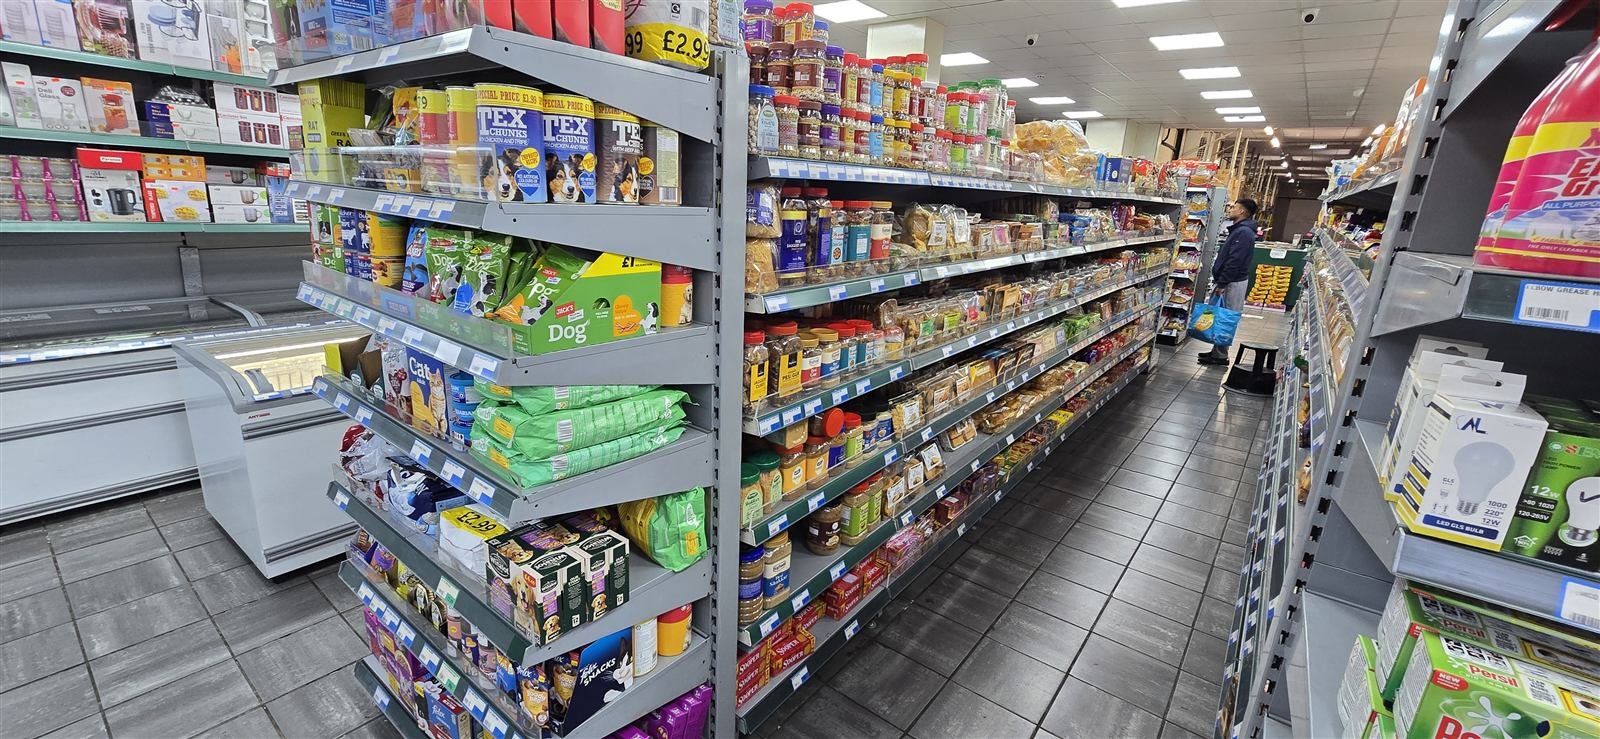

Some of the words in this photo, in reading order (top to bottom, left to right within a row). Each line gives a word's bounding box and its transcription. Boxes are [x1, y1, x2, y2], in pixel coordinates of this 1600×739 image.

[500, 91, 520, 102] PRICE
[567, 101, 583, 111] PRICE
[308, 120, 319, 131] RAT
[477, 106, 528, 135] TEX
[543, 114, 589, 142] TEX
[489, 127, 528, 139] CHUNKS
[555, 134, 589, 145] CHUNKS
[1543, 202, 1561, 210] ALL
[622, 256, 636, 268] £1
[1556, 286, 1590, 296] GREASE
[556, 304, 575, 316] JACK'S
[548, 319, 591, 344] Dog
[410, 356, 431, 381] Cat
[1488, 500, 1508, 509] 1000
[457, 510, 497, 533] £2.99
[1436, 519, 1450, 527] LED
[1451, 522, 1465, 531] GLS
[1464, 526, 1484, 535] BULB
[1481, 517, 1501, 526] 12W
[776, 639, 800, 656] SOOPER
[739, 654, 760, 675] SOOPER
[782, 651, 804, 670] SOOPER
[583, 658, 616, 687] SNACKS
[738, 668, 760, 691] SOOPER
[1438, 672, 1461, 684] NEW
[1468, 664, 1519, 688] Persil
[737, 684, 760, 708] SOOPER
